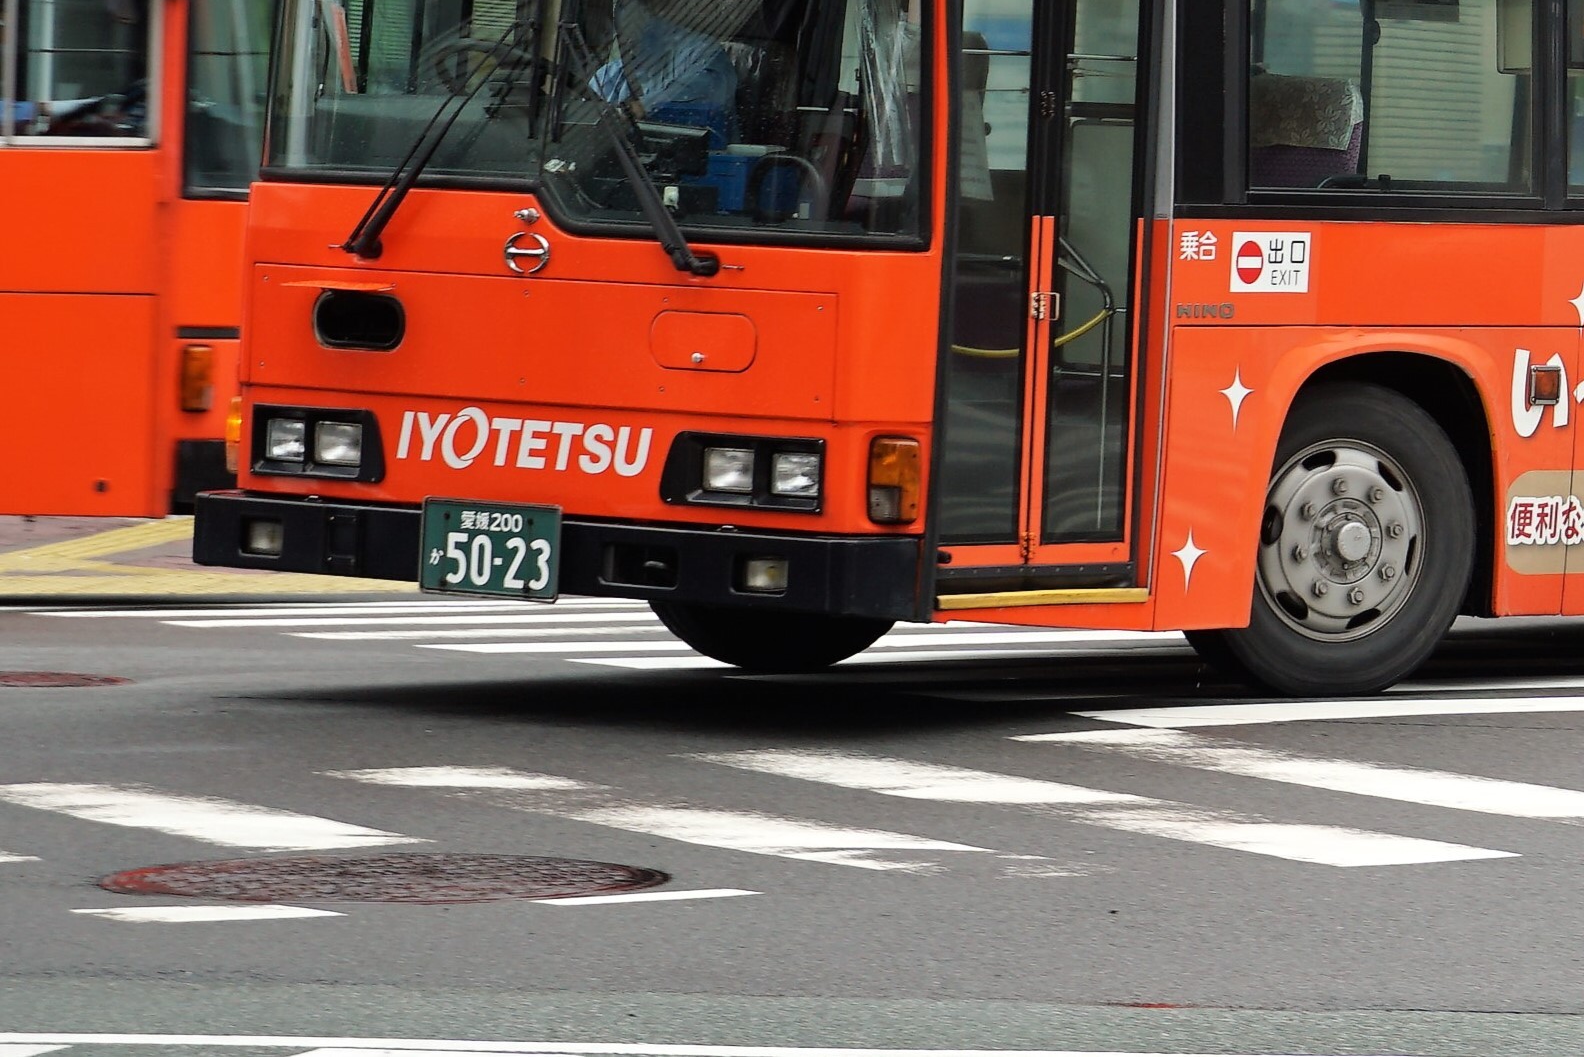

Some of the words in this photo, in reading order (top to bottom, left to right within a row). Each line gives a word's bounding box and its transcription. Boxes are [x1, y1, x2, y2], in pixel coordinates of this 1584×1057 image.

[1180, 231, 1218, 261] 乗合
[1268, 239, 1306, 264] 出口
[1271, 270, 1301, 285] EXIT
[1177, 303, 1234, 319] HINO
[396, 406, 653, 477] IYOTETSU
[460, 511, 523, 533] 愛媛200
[429, 547, 444, 566] か
[446, 532, 551, 591] 50-23
